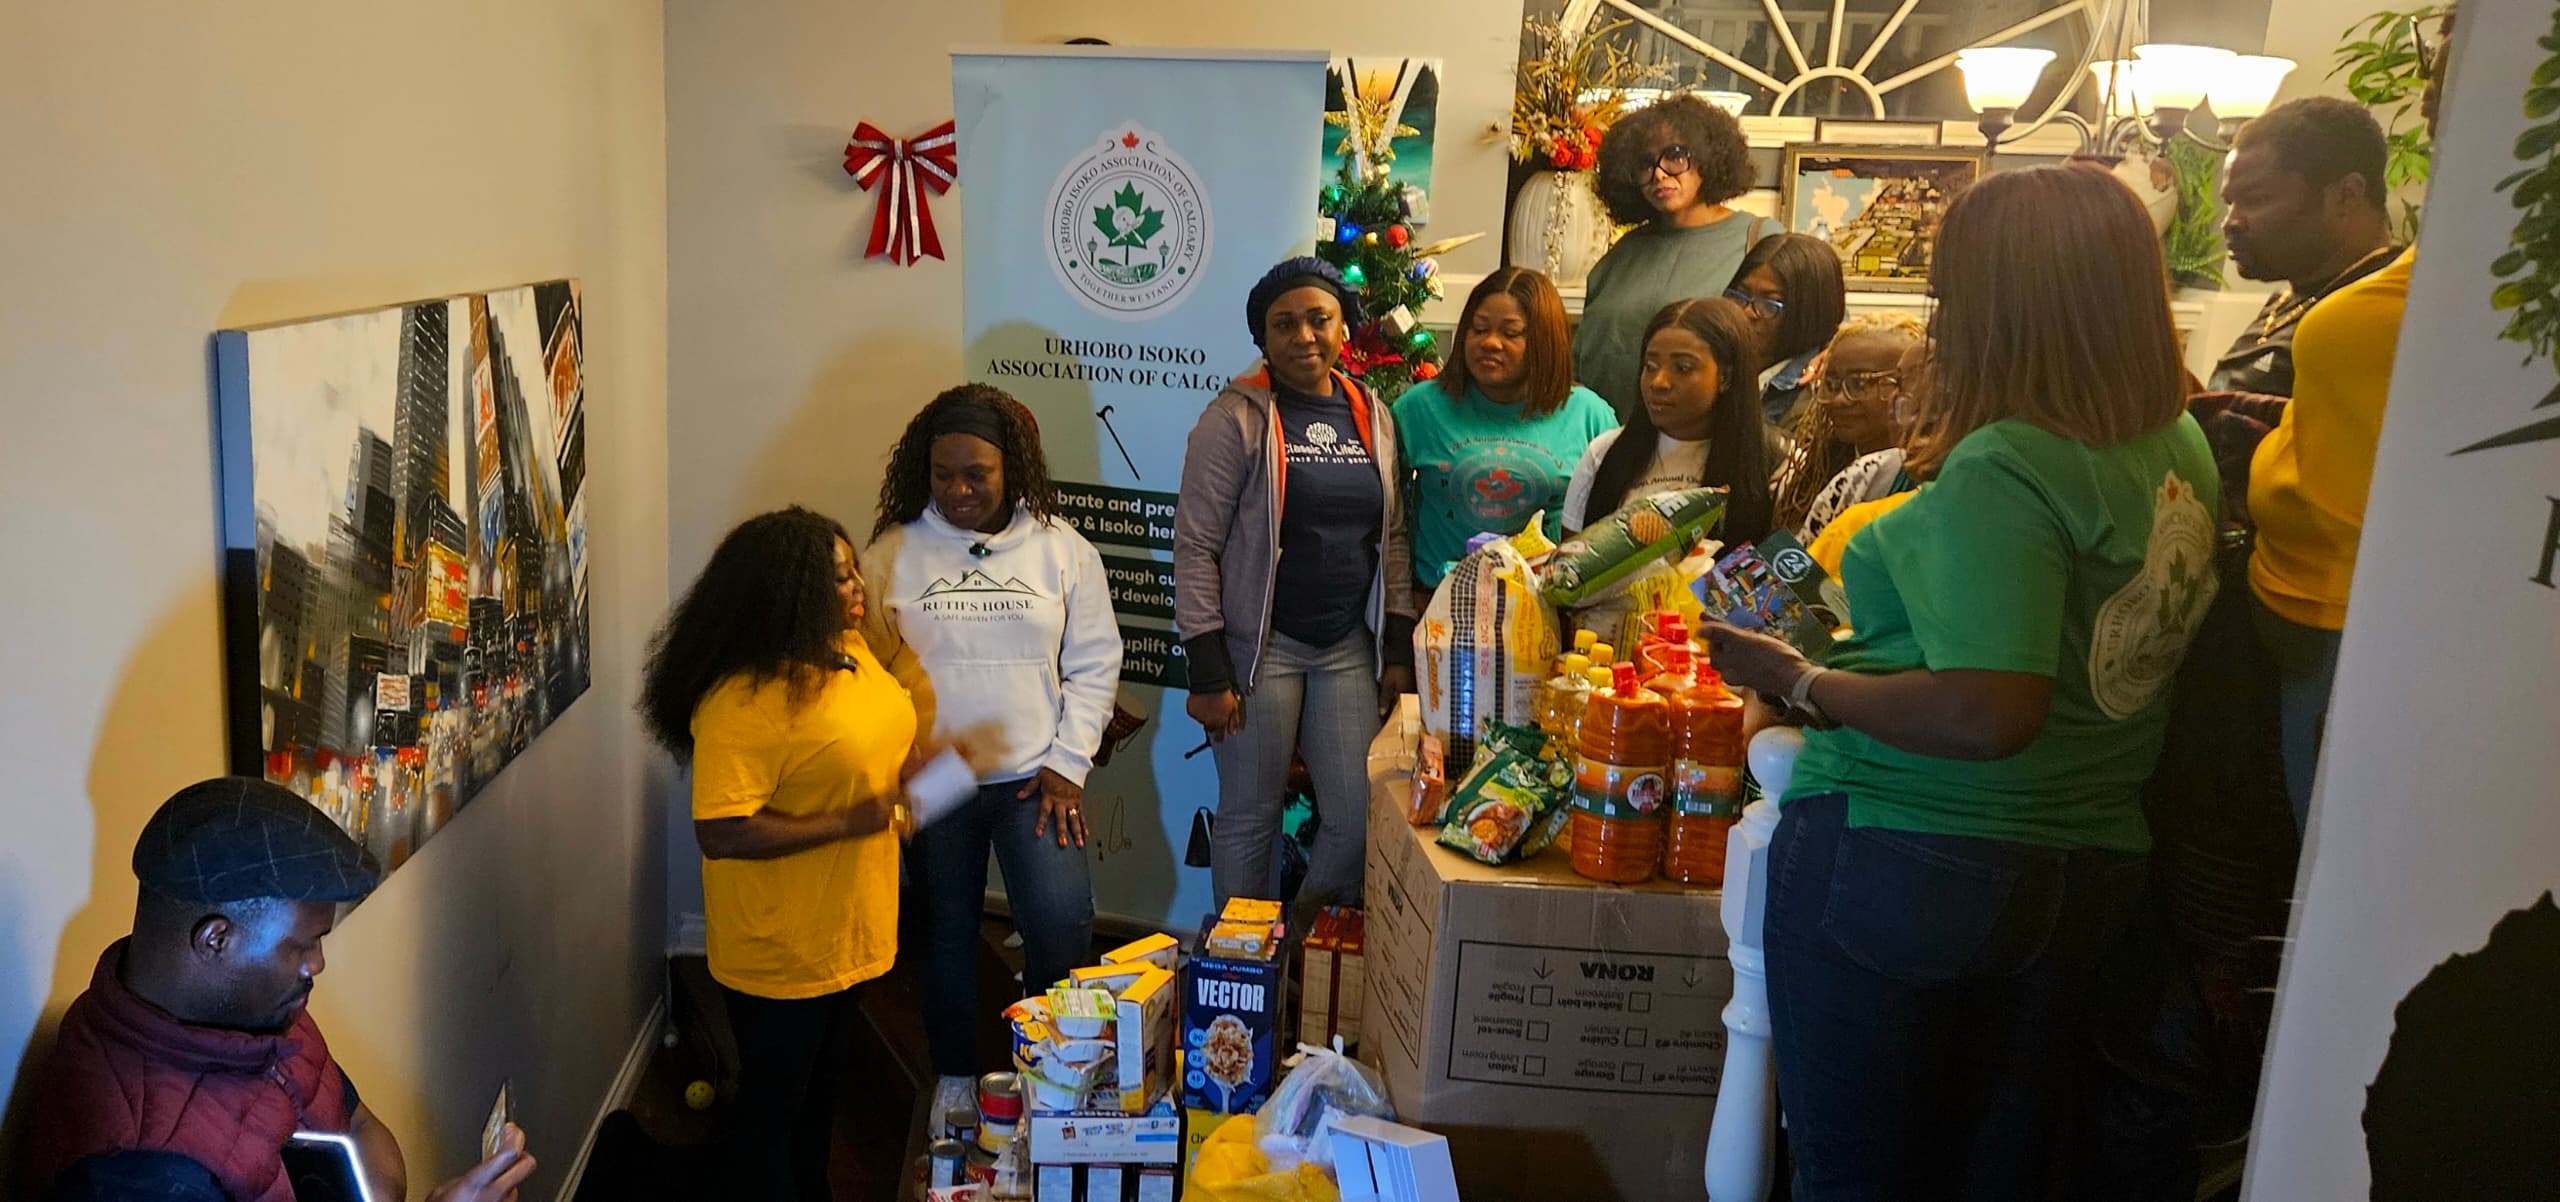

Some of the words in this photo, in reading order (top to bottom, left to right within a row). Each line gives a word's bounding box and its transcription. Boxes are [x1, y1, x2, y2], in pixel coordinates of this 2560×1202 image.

[1060, 200, 1074, 254] URHOBO
[1072, 167, 1098, 199] ISOKO
[1100, 156, 1175, 183] ASSOCIATION
[1174, 181, 1188, 198] OF
[1182, 200, 1197, 261] CALGARY
[1080, 273, 1126, 302] TOGETHER
[1129, 295, 1142, 303] WE
[1145, 279, 1175, 300] STAND
[1045, 338, 1133, 361] URHOBO
[1139, 345, 1206, 366] ISOKO
[987, 359, 1123, 384] ASSOCIATION
[1129, 368, 1158, 386] OF
[1108, 498, 1141, 514] and
[1145, 502, 1176, 518] pre
[1084, 515, 1096, 531] &
[1100, 517, 1145, 536] Isoko
[923, 600, 978, 613] RUTH'S
[983, 599, 1034, 612] HOUSE
[1122, 588, 1176, 609] develo
[962, 615, 988, 623] HAVEN
[1121, 637, 1168, 655] uplift
[1579, 962, 1655, 983] RONA
[1197, 977, 1265, 1013] VECTOR
[1487, 1061, 1519, 1073] Salon
